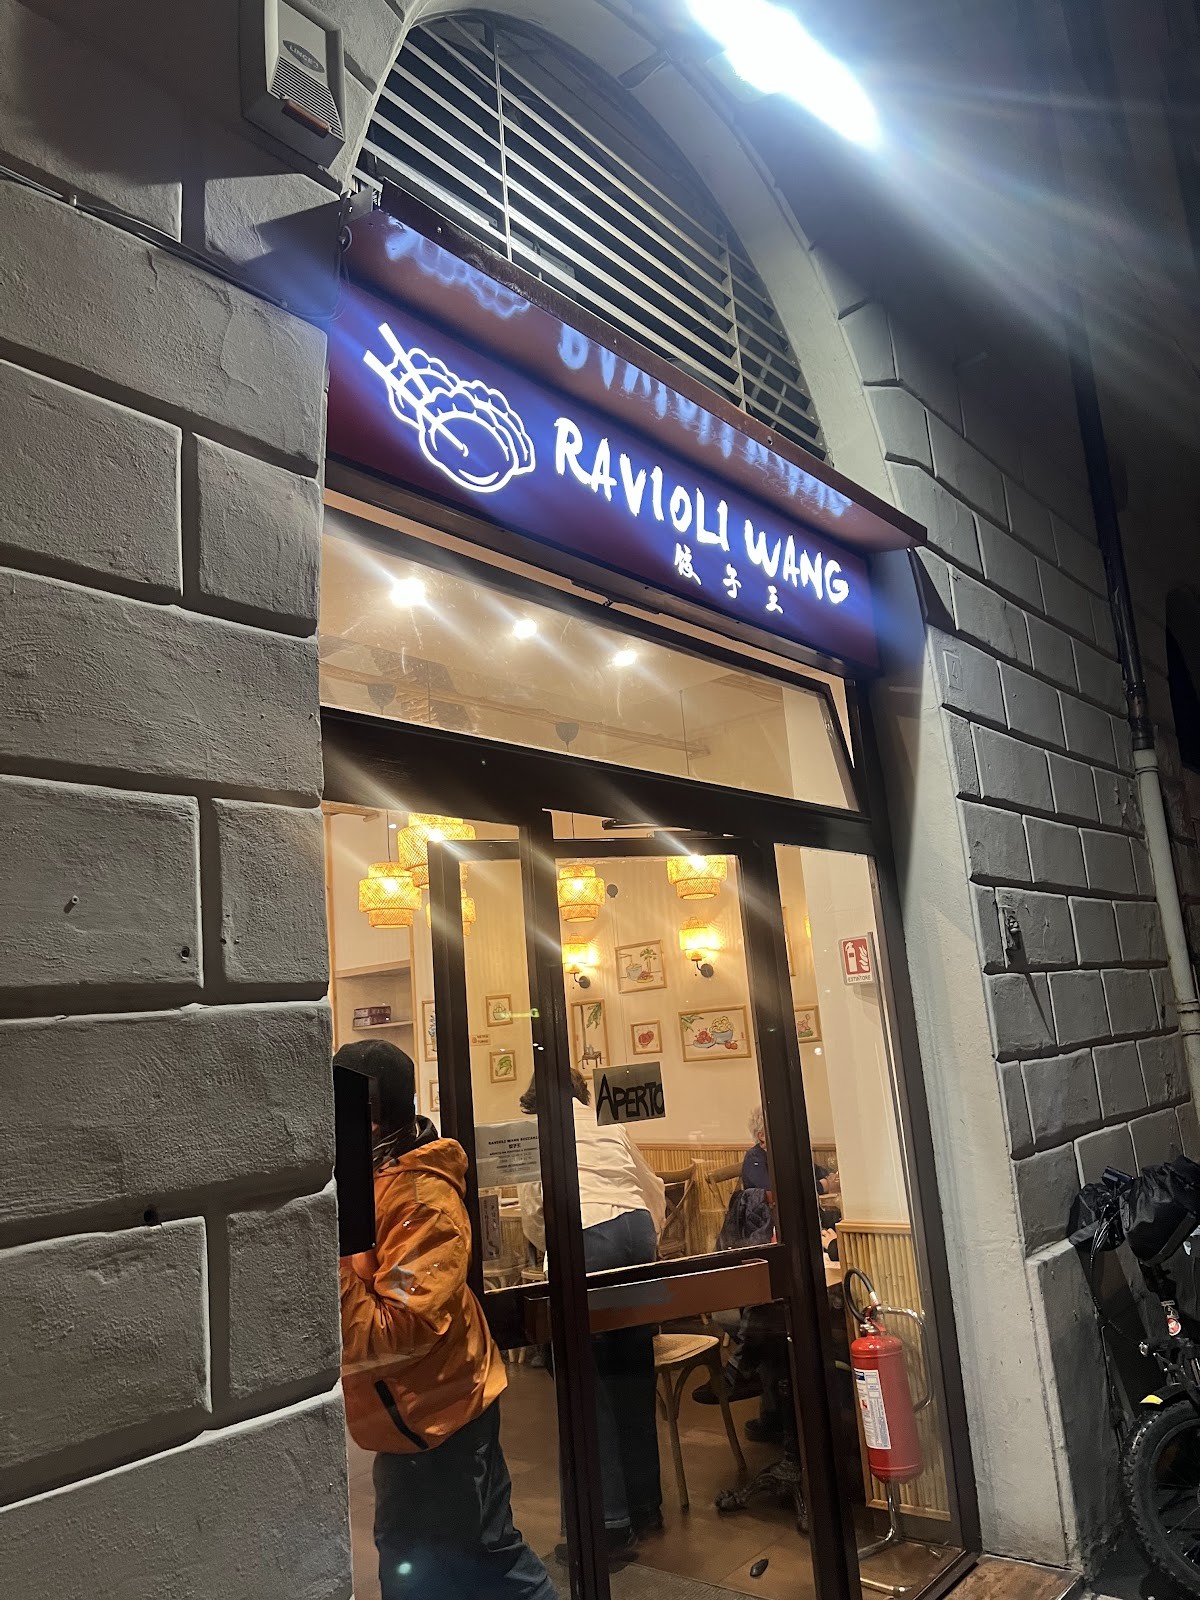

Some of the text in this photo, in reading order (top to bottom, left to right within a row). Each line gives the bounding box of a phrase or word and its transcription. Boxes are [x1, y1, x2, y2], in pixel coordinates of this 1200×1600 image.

[554, 417, 849, 604] RAVIOLI WANG
[847, 974, 872, 983] ESTINTORE
[597, 1073, 664, 1122] APERTO
